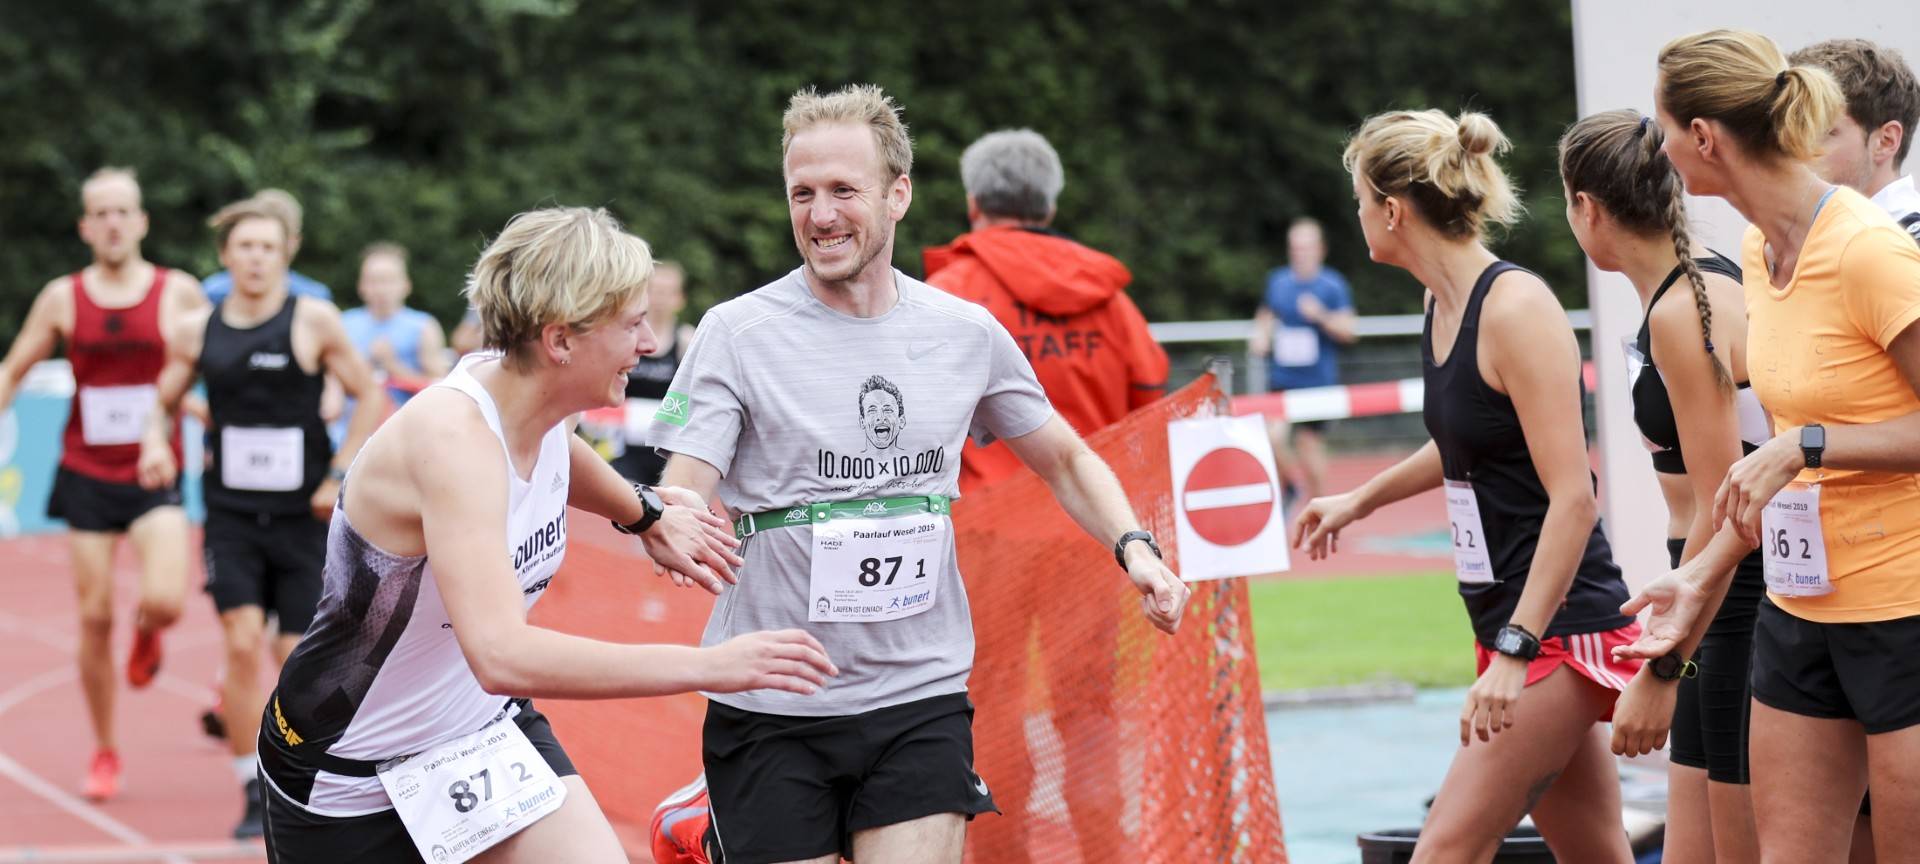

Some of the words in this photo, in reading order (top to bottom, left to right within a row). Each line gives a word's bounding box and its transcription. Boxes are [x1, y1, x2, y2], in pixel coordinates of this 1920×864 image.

[1017, 331, 1103, 360] TAFF
[662, 396, 687, 415] OK
[818, 448, 875, 479] 10.000
[893, 445, 944, 477] 10.000
[784, 508, 809, 520] AOK
[863, 502, 888, 512] AOK
[1792, 502, 1808, 511] 2019
[853, 529, 891, 540] Paarlauf
[893, 527, 916, 537] Wesel
[917, 523, 936, 534] 2019
[1465, 530, 1476, 548] 2
[1799, 538, 1812, 559] 2
[858, 555, 903, 587] 87
[915, 558, 926, 579] 1
[1795, 572, 1821, 585] bunert
[902, 589, 930, 607] bunert
[423, 750, 459, 773] Paarlauf
[486, 731, 508, 746] 2019
[448, 768, 493, 814] 87
[510, 761, 534, 784] 2
[518, 786, 556, 813] bunert
